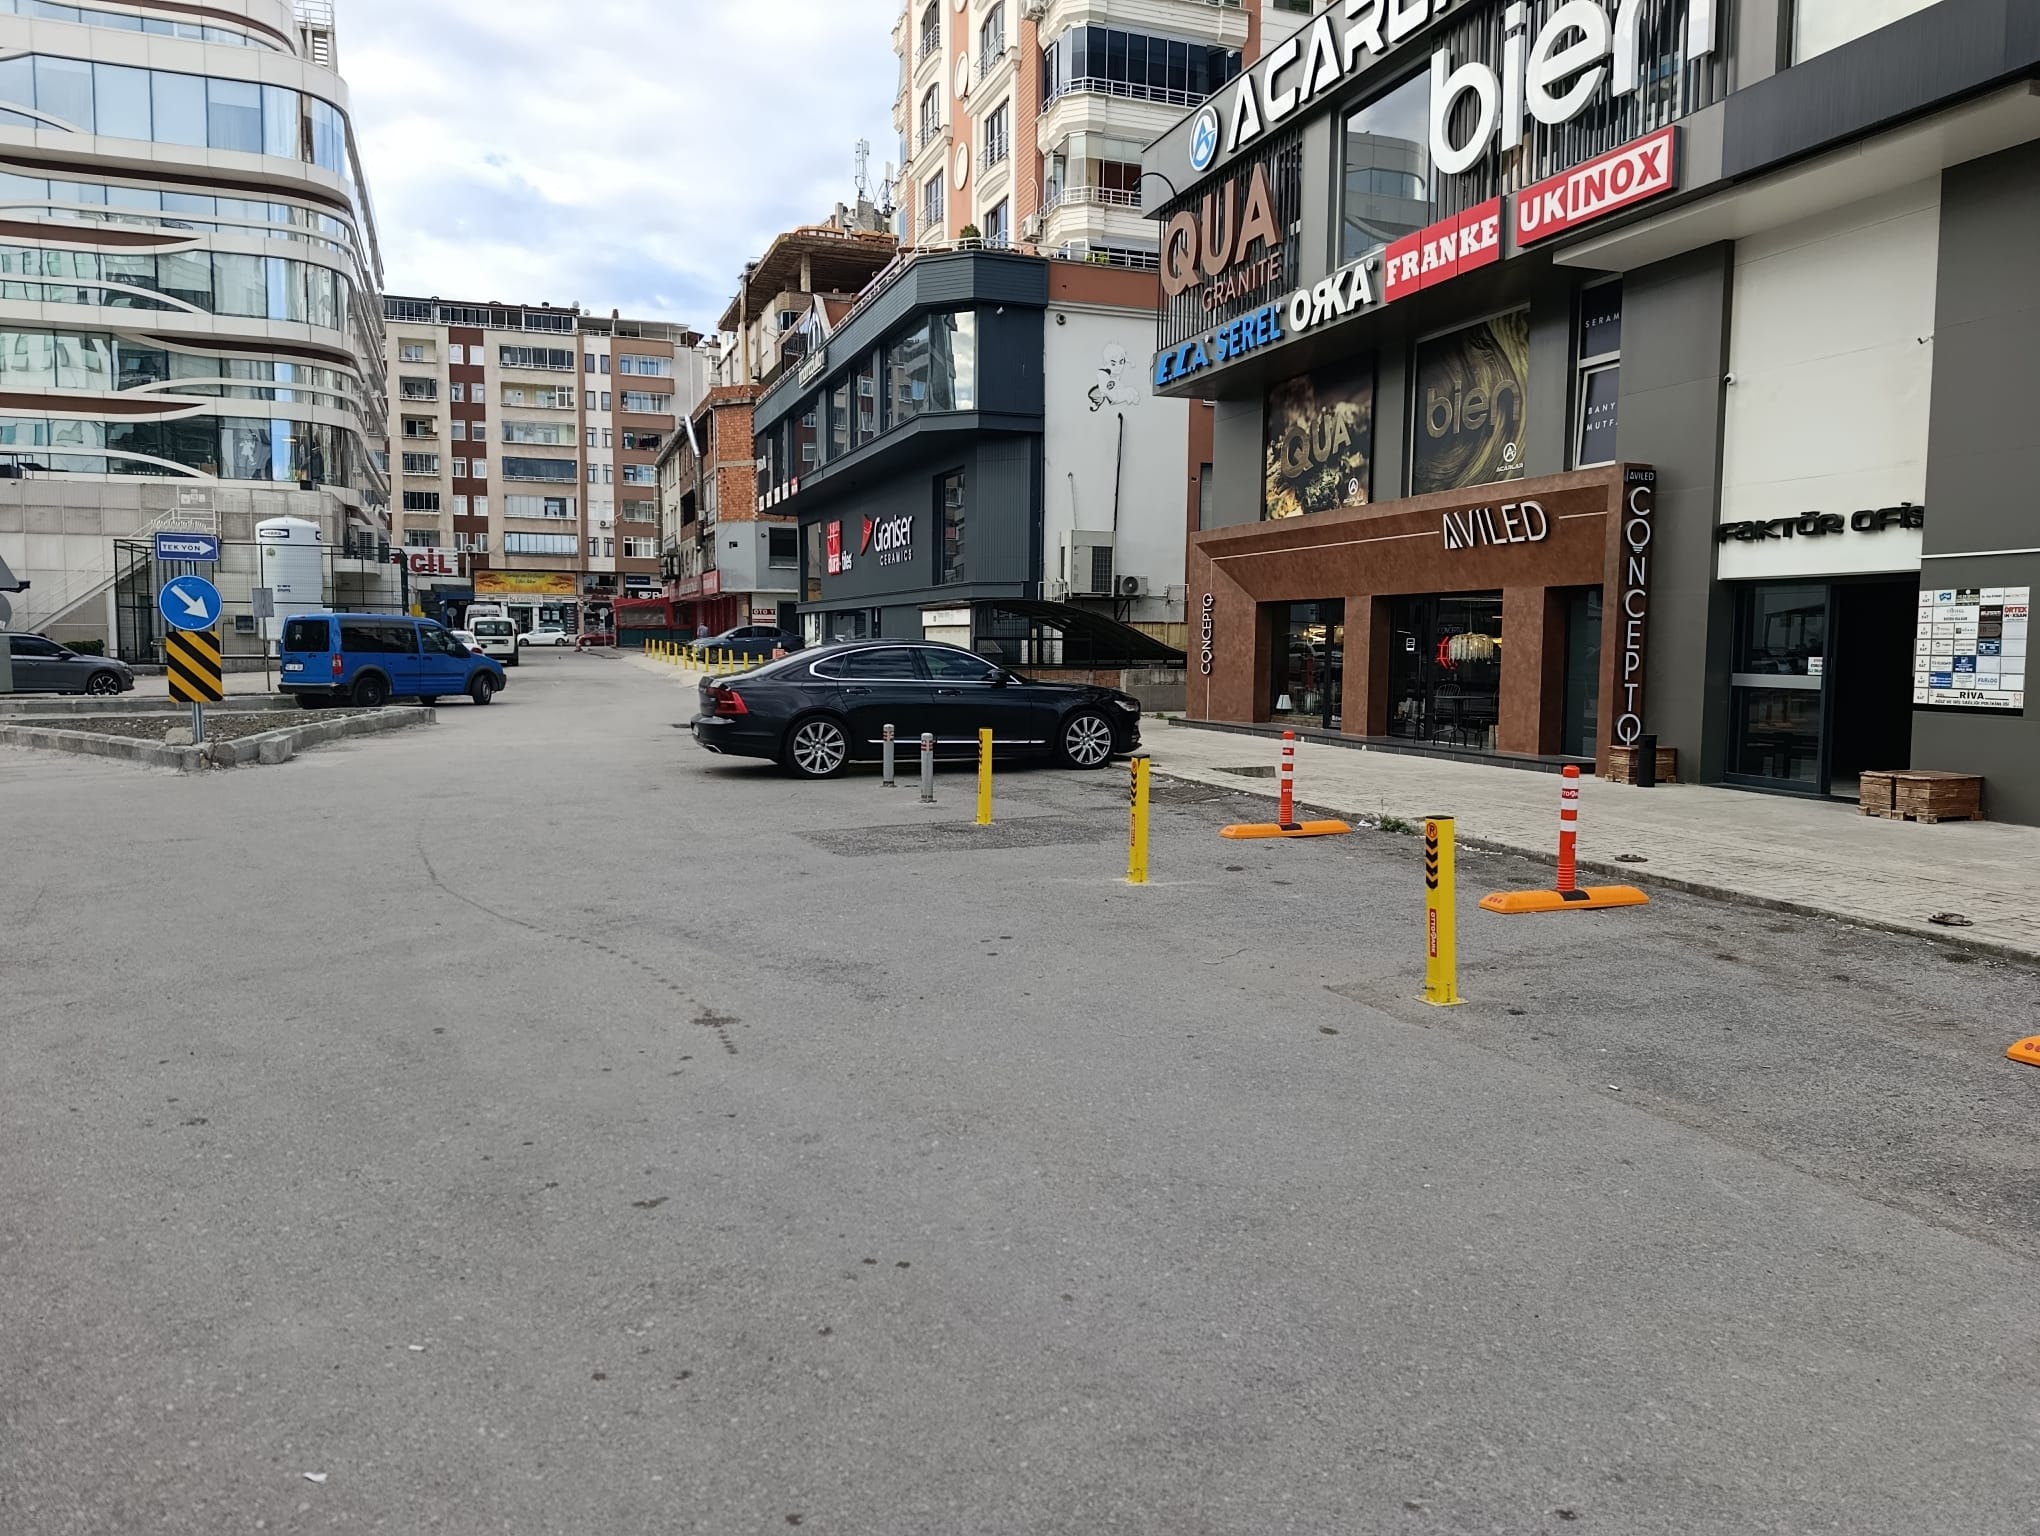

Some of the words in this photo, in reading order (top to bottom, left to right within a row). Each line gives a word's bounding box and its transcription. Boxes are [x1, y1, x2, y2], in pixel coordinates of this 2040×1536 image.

[1227, 0, 1452, 153] ACARL
[1520, 144, 1663, 232] UKINOX
[1160, 162, 1283, 298] QUA
[1386, 214, 1499, 288] FRANKE
[1201, 251, 1282, 313] GRANITE
[1216, 304, 1283, 363] SEREL
[1426, 380, 1520, 438] bien
[1280, 412, 1351, 478] QUA
[1629, 469, 1655, 483] AVILED
[873, 514, 913, 552] Graniser
[1443, 500, 1548, 550] AVILED
[880, 549, 912, 566] CERAMICS
[1201, 593, 1213, 675] CONCEPTO
[1616, 486, 1651, 746] CONCEPTO
